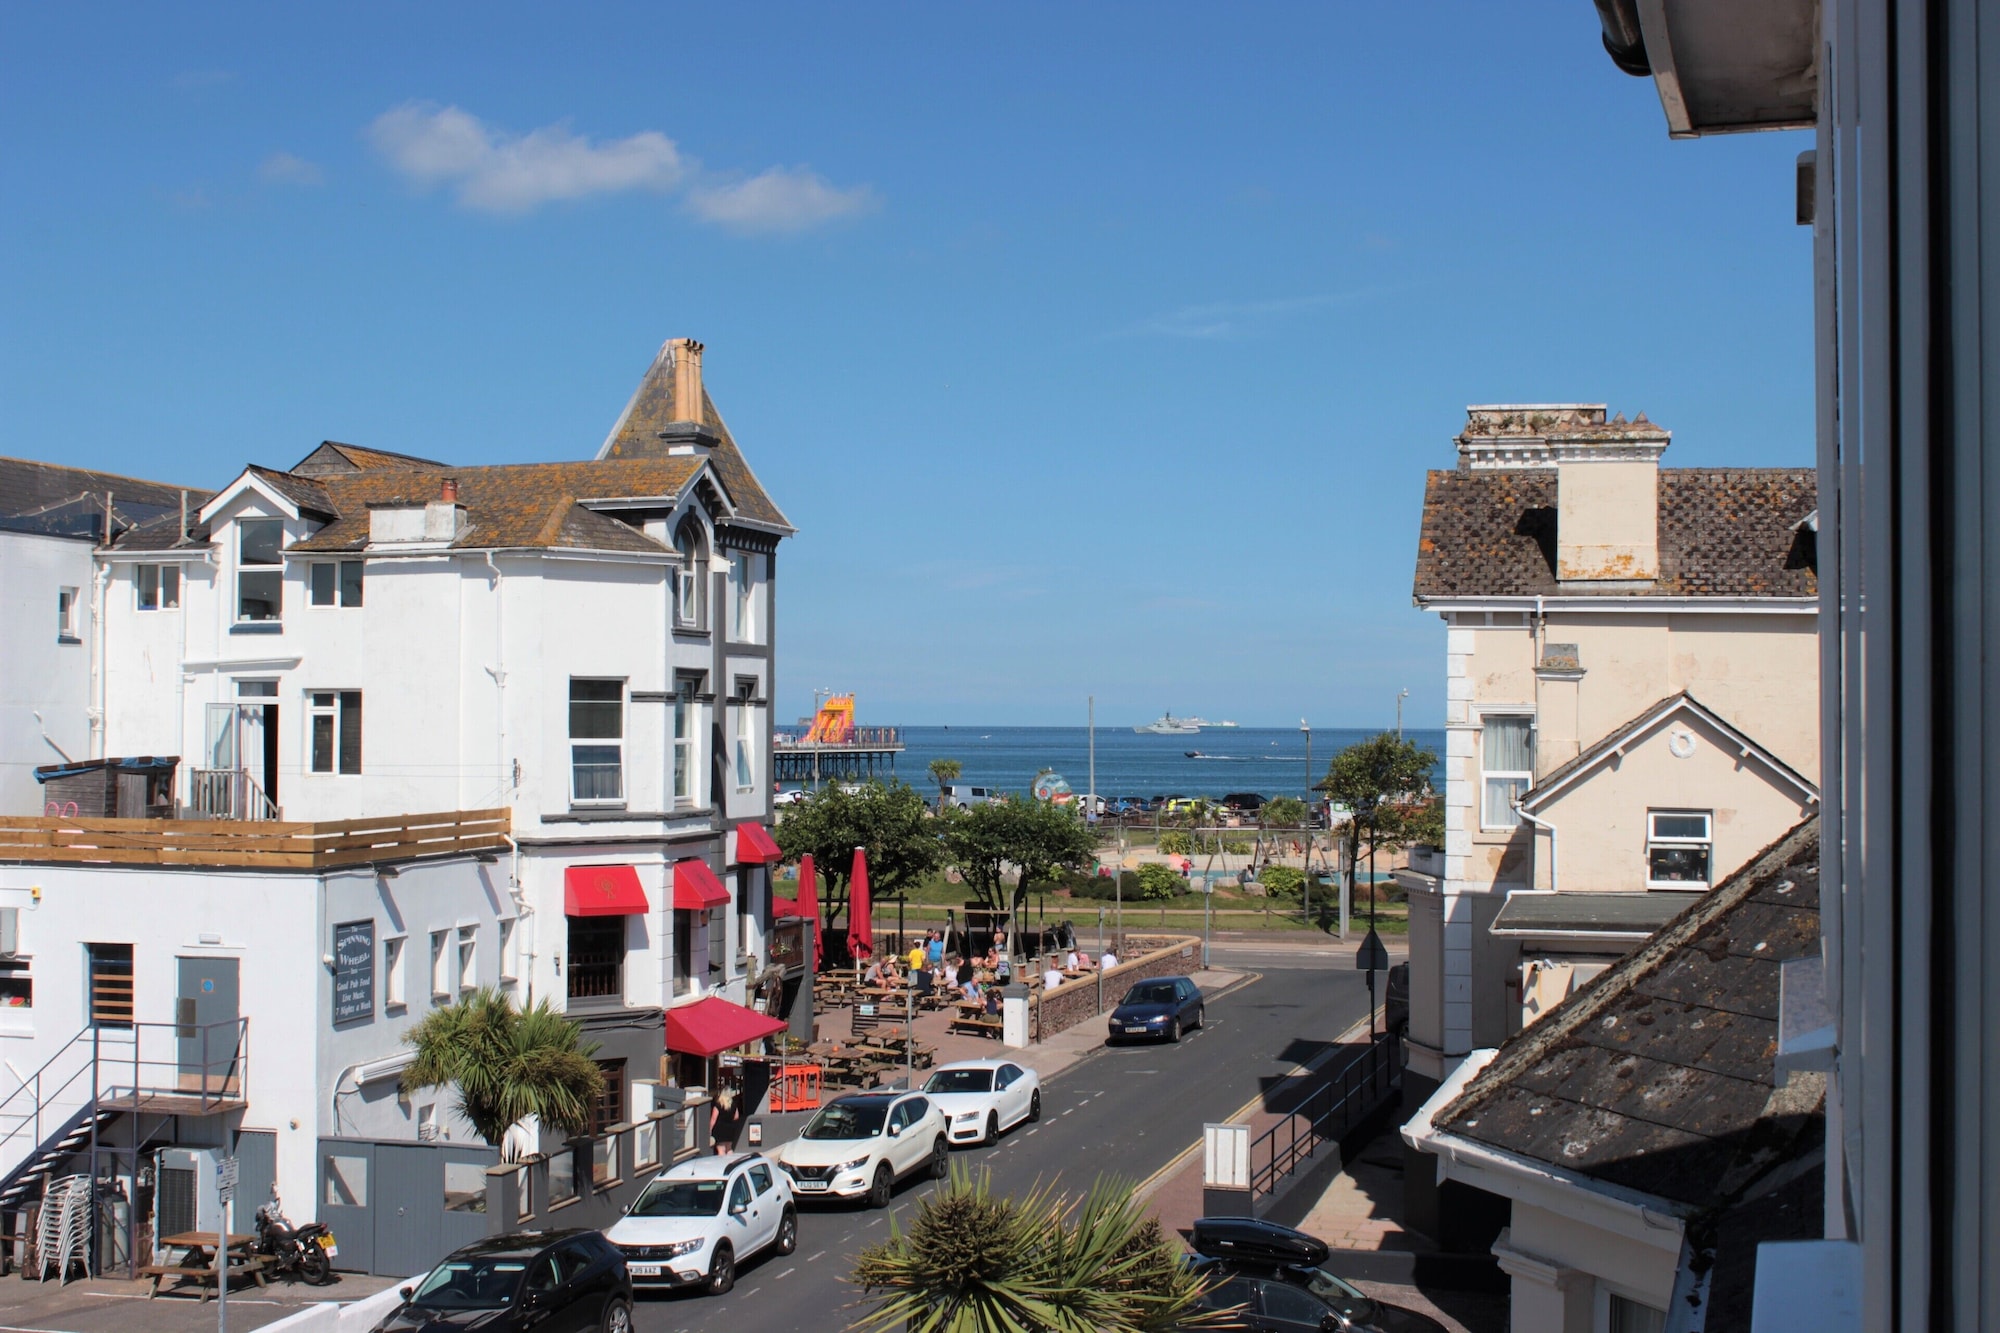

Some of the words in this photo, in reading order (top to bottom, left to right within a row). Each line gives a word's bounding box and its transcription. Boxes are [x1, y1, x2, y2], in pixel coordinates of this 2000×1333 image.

[337, 935, 371, 951] SPINNING
[340, 953, 370, 966] WHEEL
[337, 980, 349, 992] Good
[350, 979, 359, 989] Pub
[360, 976, 371, 987] Food
[342, 993, 351, 1003] Live
[353, 990, 365, 1000] Music
[340, 1005, 355, 1016] Nights
[361, 1000, 371, 1010] Week
